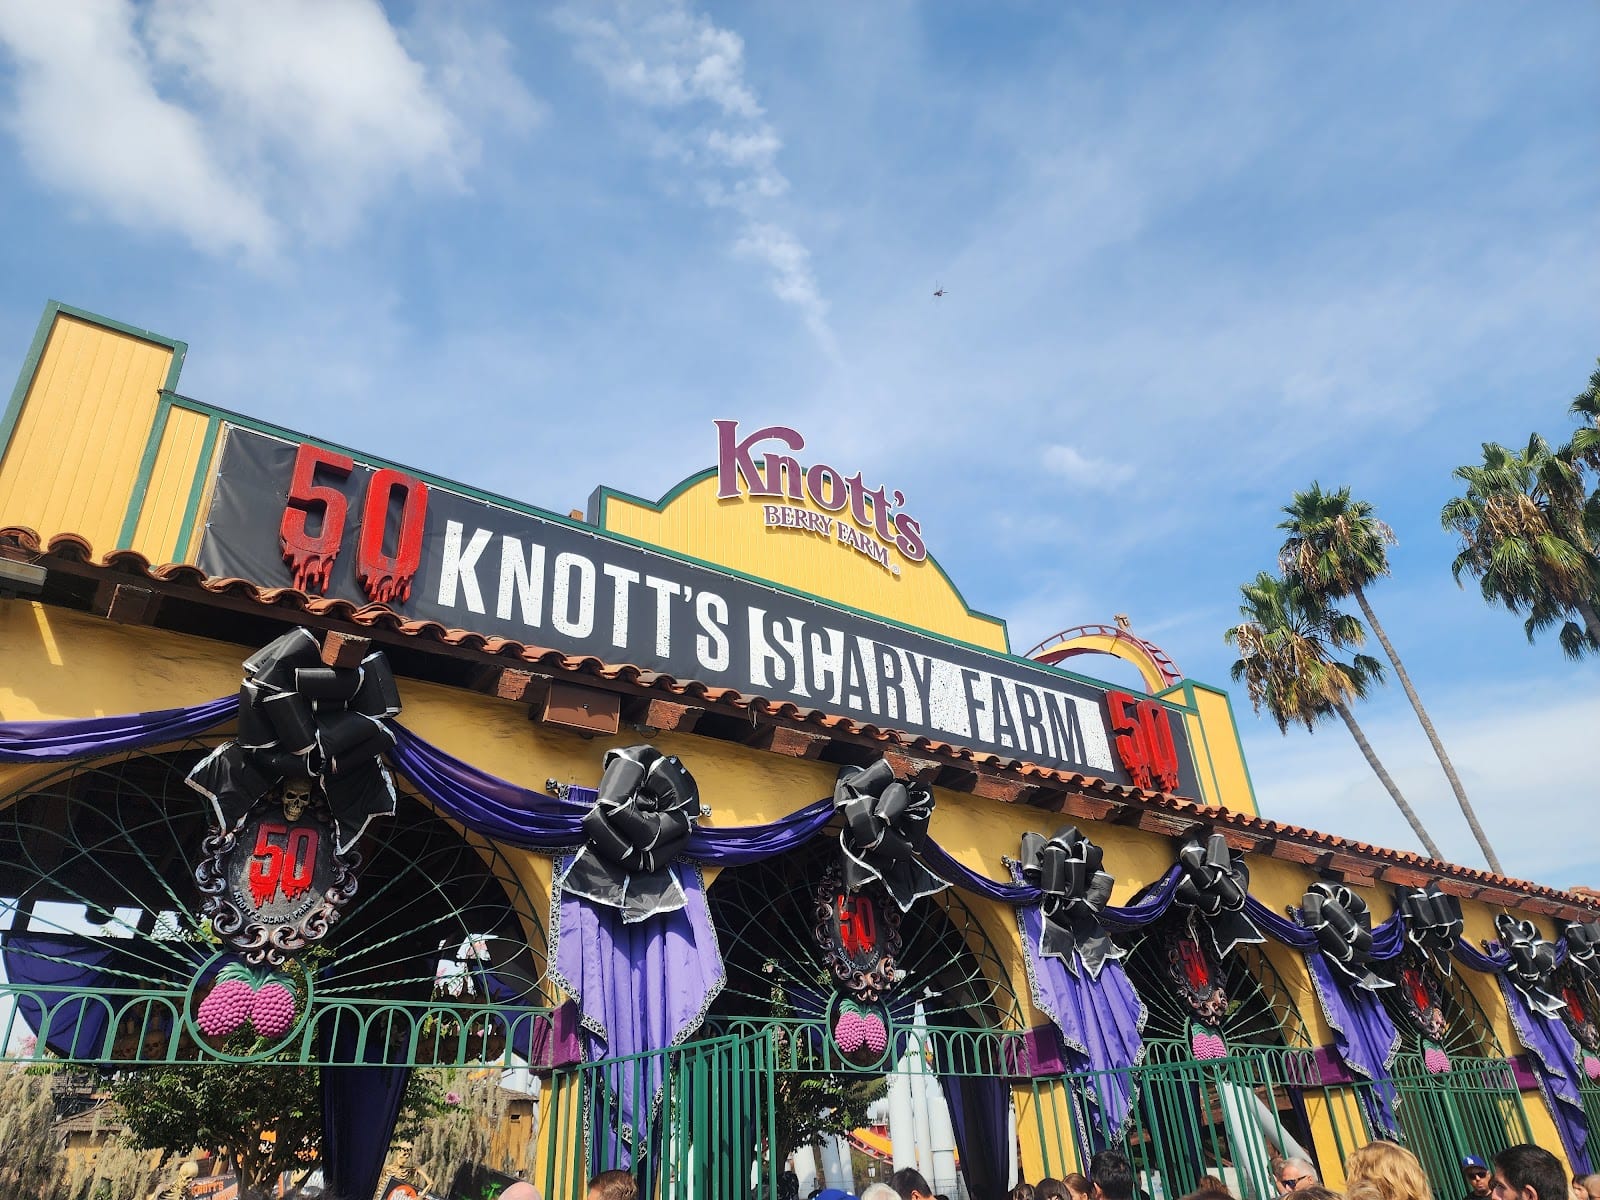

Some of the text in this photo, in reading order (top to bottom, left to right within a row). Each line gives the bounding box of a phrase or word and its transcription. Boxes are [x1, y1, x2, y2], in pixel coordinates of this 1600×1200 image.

[279, 443, 430, 603] 50
[713, 419, 927, 561] Knott's
[763, 504, 889, 569] BERRY FARM
[437, 519, 1088, 768] KNOTT'S SCARY FARM
[1105, 689, 1179, 793] 50
[248, 823, 320, 909] 50
[837, 895, 876, 961] 50
